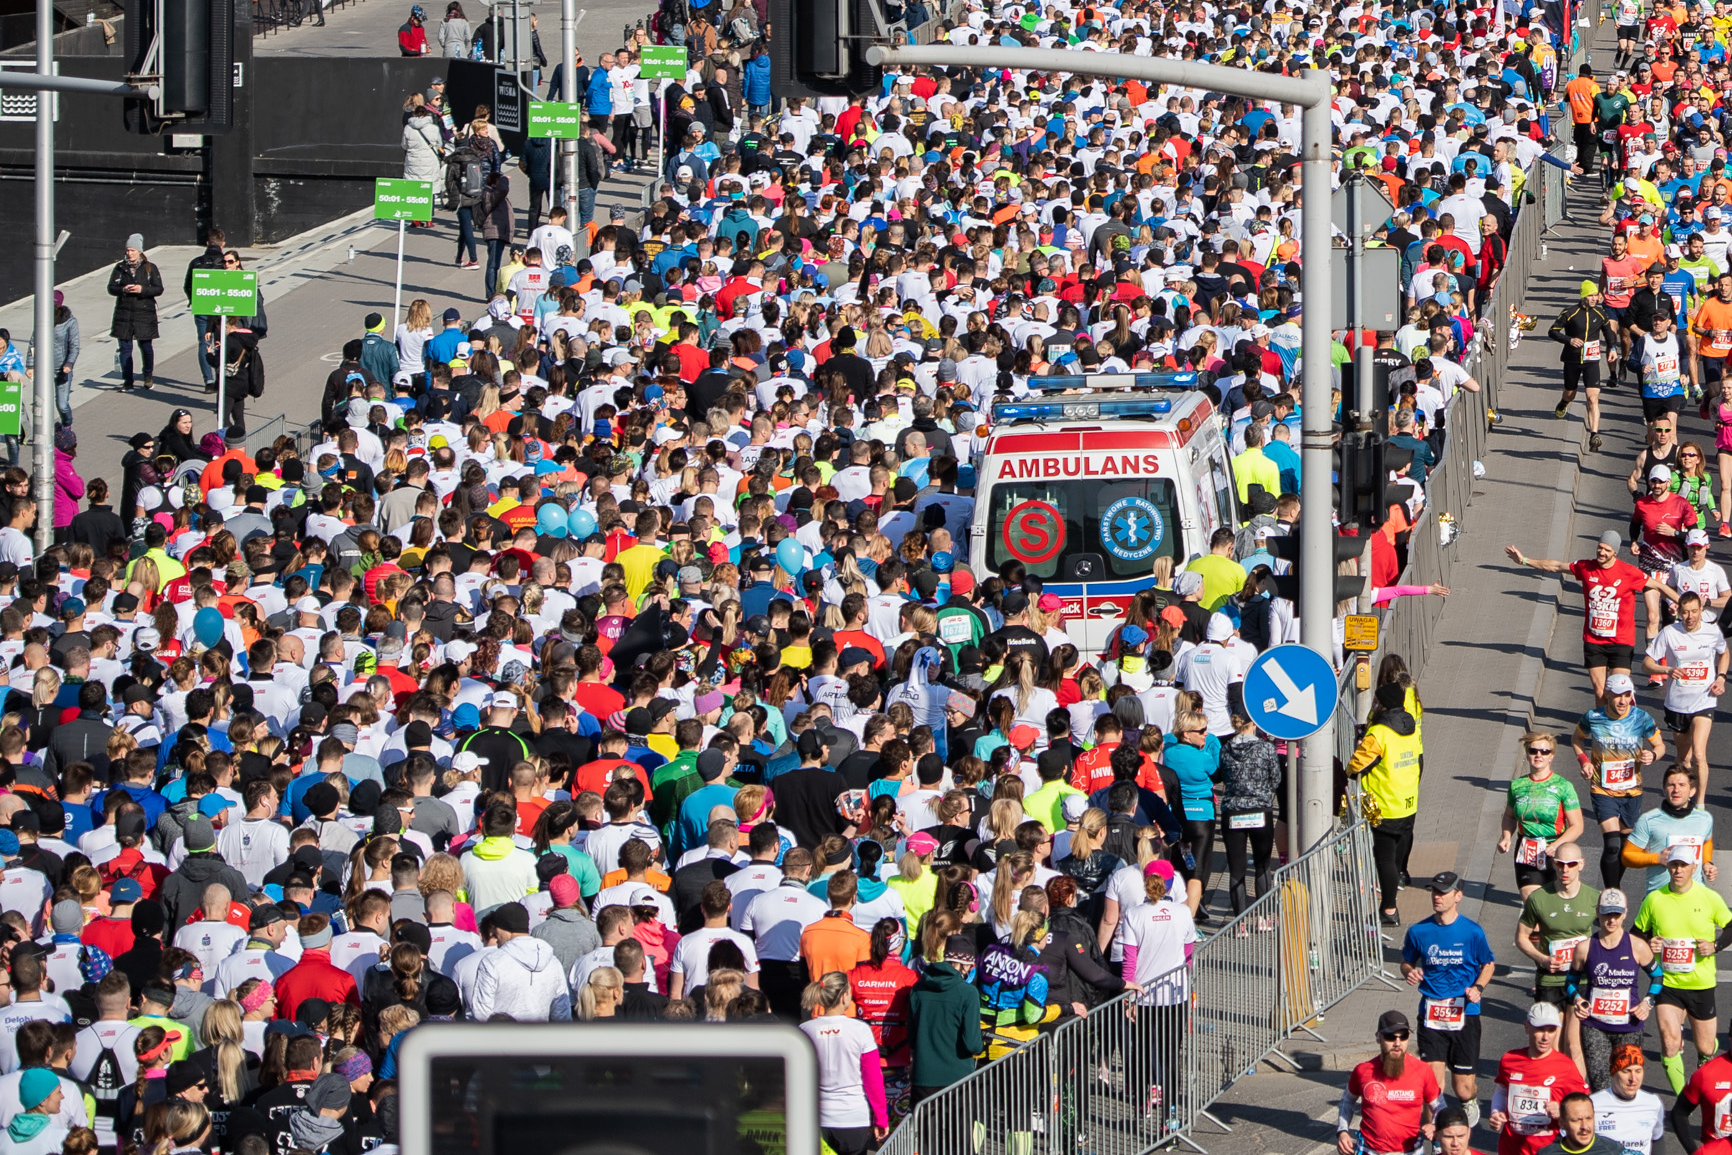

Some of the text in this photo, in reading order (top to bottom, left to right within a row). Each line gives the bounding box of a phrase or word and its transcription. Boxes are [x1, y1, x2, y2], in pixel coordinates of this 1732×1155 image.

[531, 116, 550, 124] 50:01
[556, 117, 576, 125] 55:00
[378, 194, 400, 203] 50:01
[406, 196, 429, 206] 55:00
[196, 287, 221, 297] 50:01
[227, 289, 253, 299] 55:00
[998, 454, 1160, 479] AMBULANS
[1103, 498, 1162, 543] PAŃSTWOWE RATOWNICTWO
[1019, 513, 1049, 552] S
[1112, 545, 1154, 560] MEDYCZNE
[1593, 618, 1613, 629] 1360
[1686, 666, 1706, 678] 5396
[1666, 947, 1689, 961] 5253
[983, 950, 1032, 981] ANTON
[985, 963, 1019, 986] TEAM
[857, 980, 897, 988] GARMIN
[1597, 998, 1623, 1012] 3252
[1433, 1006, 1459, 1020] 3592
[1519, 1099, 1539, 1112] 834
